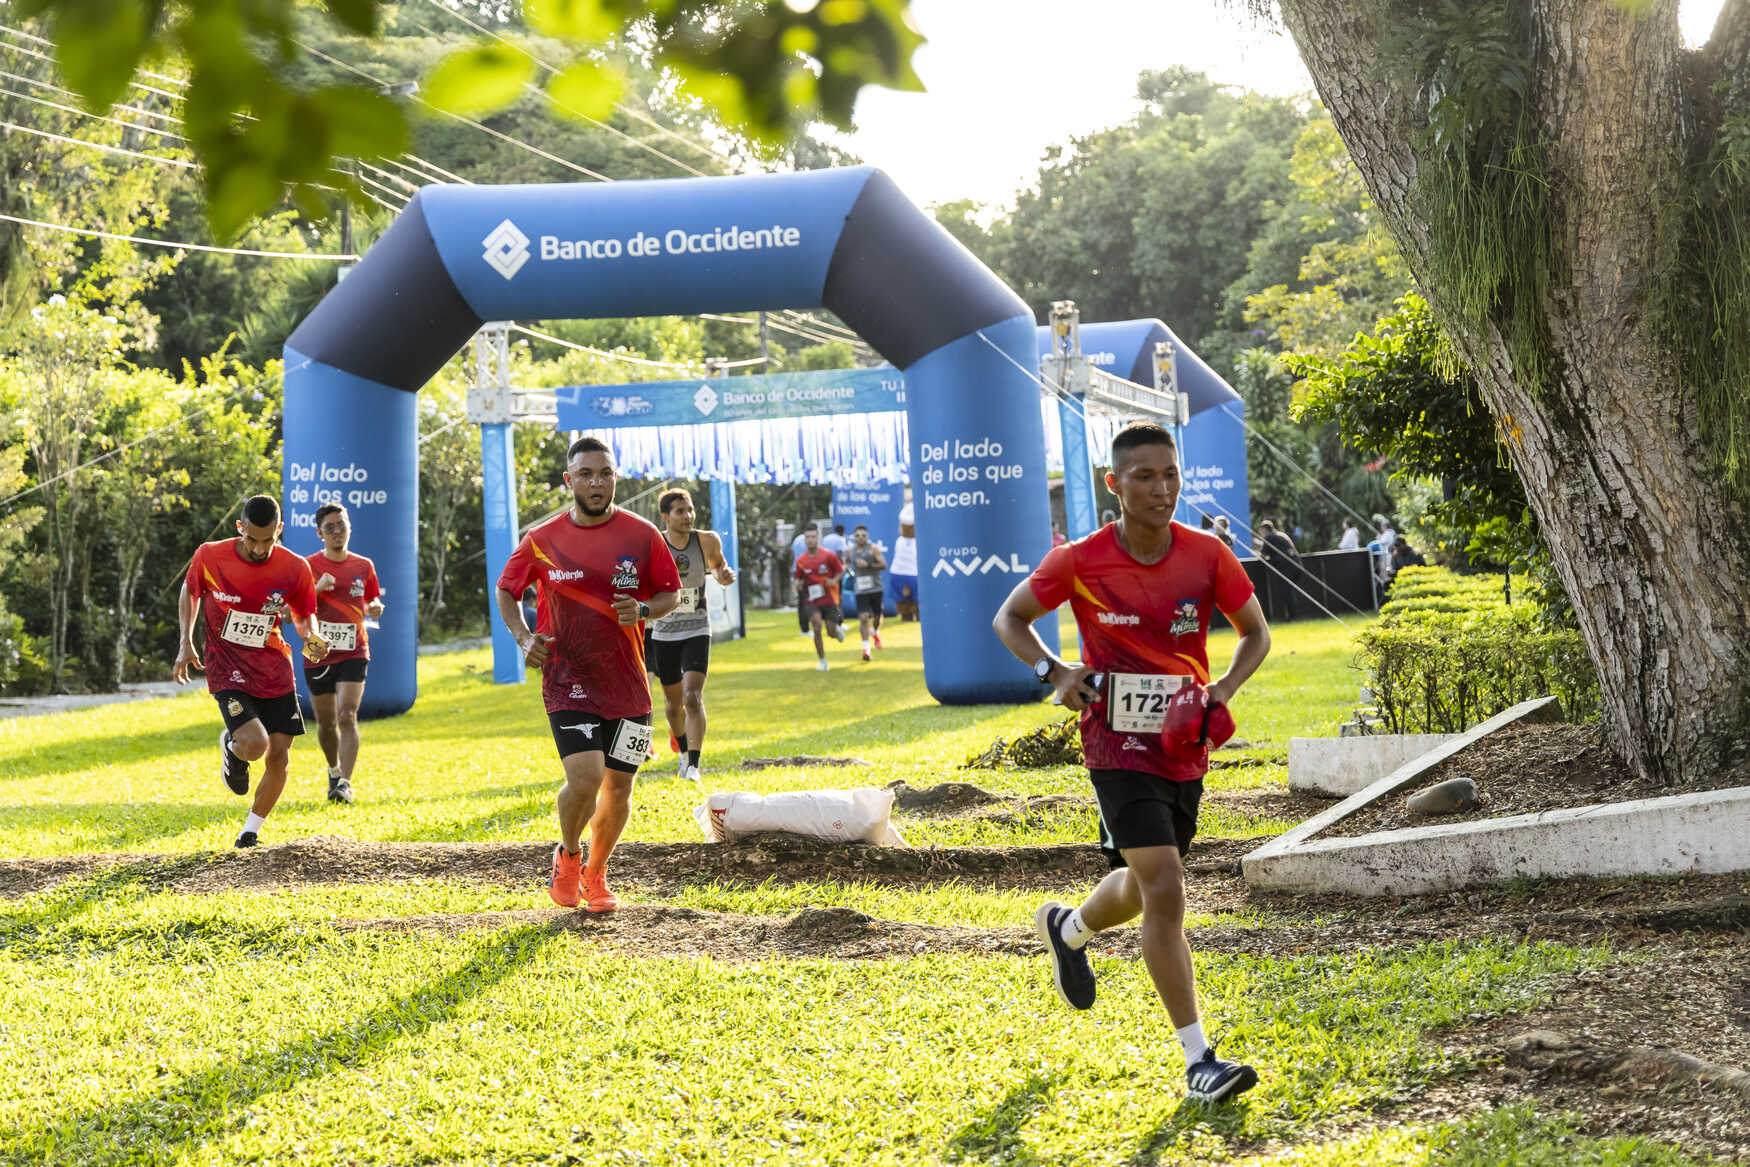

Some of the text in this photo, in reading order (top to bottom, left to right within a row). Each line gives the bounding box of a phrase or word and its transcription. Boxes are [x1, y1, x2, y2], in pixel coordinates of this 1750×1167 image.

[540, 225, 801, 261] Banco de Occidente
[723, 386, 855, 405] Banco de Occidente
[920, 437, 1003, 463] Del lado
[290, 462, 368, 482] Del lado
[922, 462, 1023, 485] de los que
[290, 483, 387, 509] de los que
[925, 490, 990, 510] hacen.
[290, 508, 318, 527] hac
[939, 546, 978, 557] Grupo
[931, 553, 1030, 578] AVAL
[232, 621, 265, 637] 1376
[626, 736, 650, 753] 383
